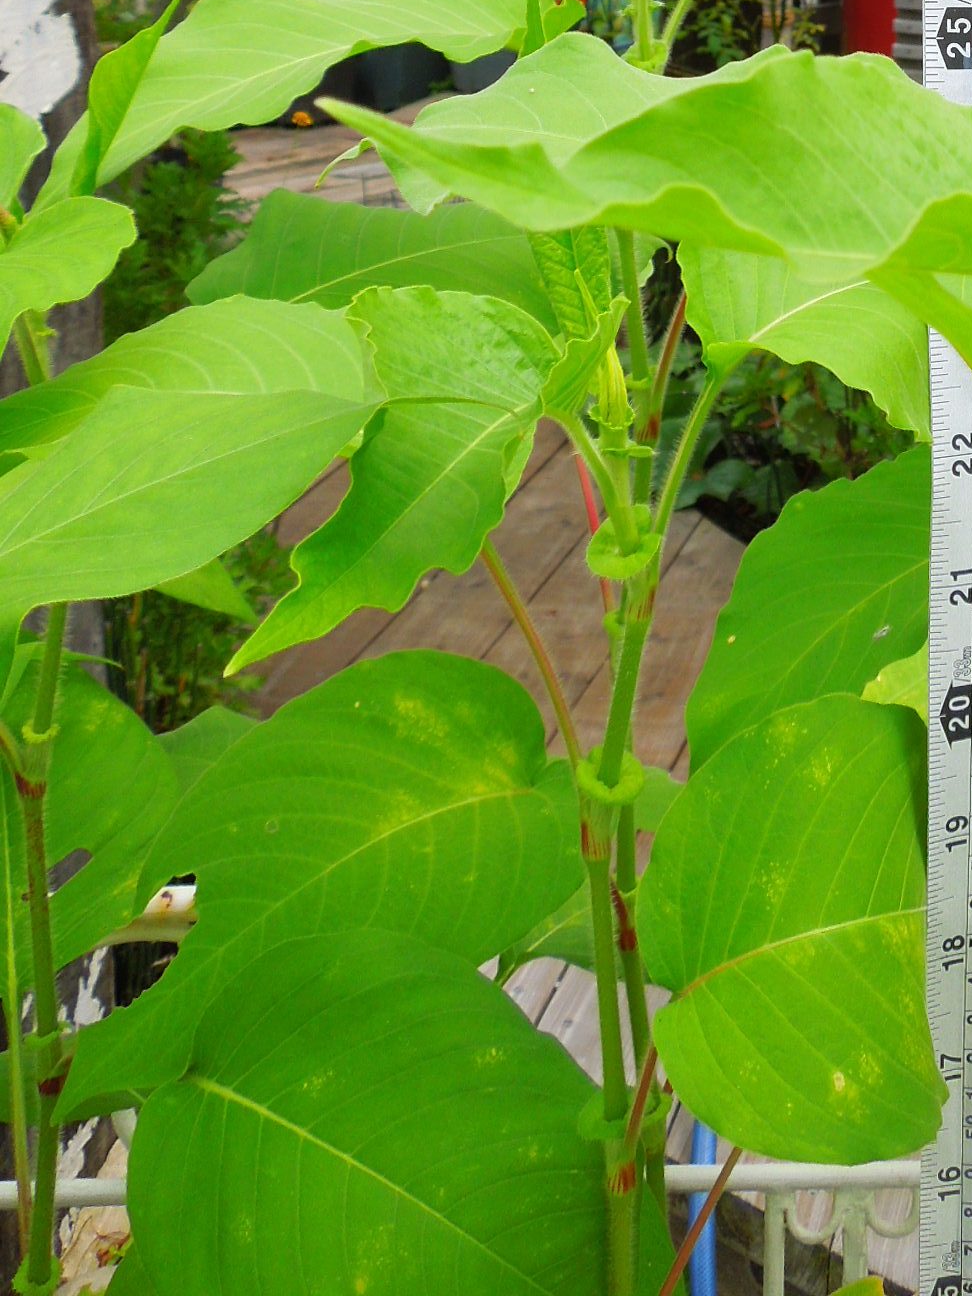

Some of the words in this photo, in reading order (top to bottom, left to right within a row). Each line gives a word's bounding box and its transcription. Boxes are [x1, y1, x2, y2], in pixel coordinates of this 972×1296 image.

[946, 17, 972, 58] 25
[950, 569, 972, 606] 21
[949, 695, 970, 731] 20
[946, 815, 969, 853] 19
[942, 935, 965, 971] 18
[940, 1054, 961, 1081] 17
[938, 1167, 961, 1202] 16
